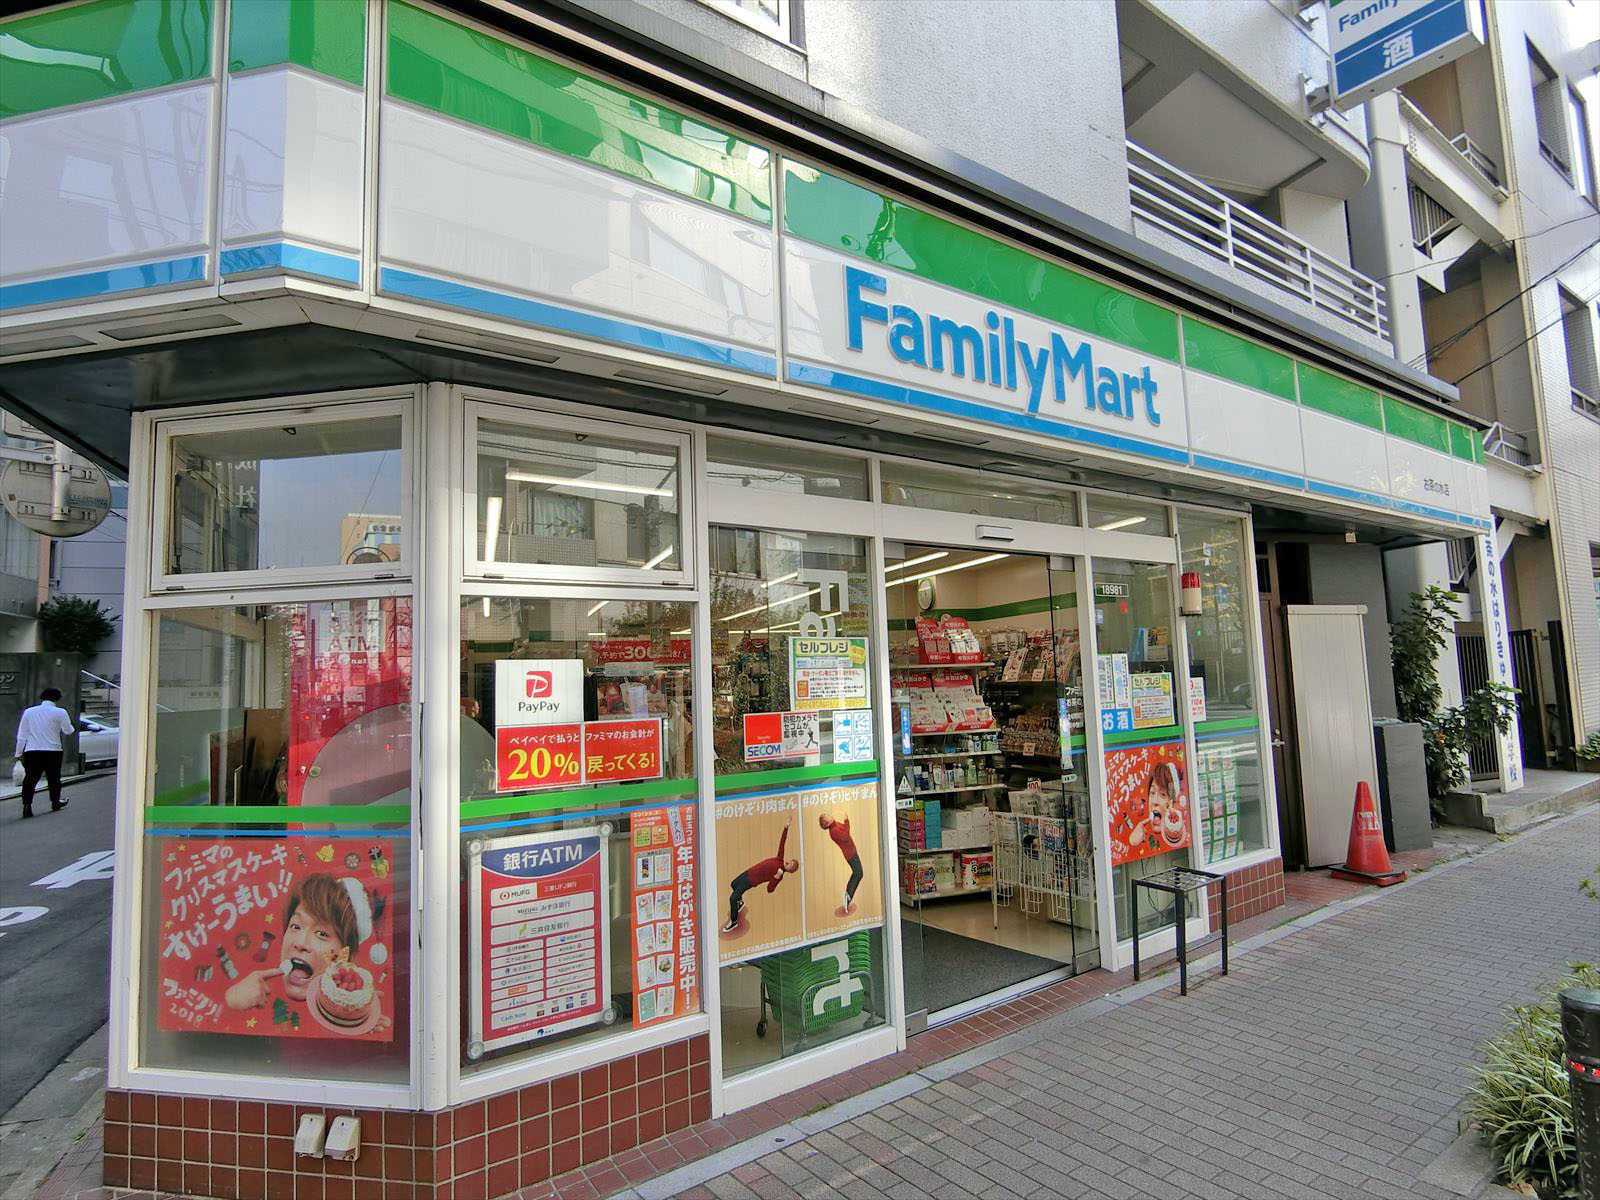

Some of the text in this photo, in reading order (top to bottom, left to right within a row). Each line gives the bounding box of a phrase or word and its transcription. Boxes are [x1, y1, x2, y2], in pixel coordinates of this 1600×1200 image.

[1339, 0, 1399, 32] Fami
[1382, 30, 1414, 69] 酒
[842, 264, 1161, 427] FamilyMart
[1100, 584, 1122, 595] 18981
[799, 641, 849, 654] セルフレジ
[518, 700, 560, 712] PayPay
[783, 722, 809, 731] セコムが
[784, 714, 818, 724] 防犯カメラで
[1103, 711, 1129, 731] お酒
[509, 733, 580, 746] ペイペイで払うと
[585, 728, 655, 741] ファミマのお会計が
[784, 730, 805, 739] 監視中
[747, 745, 781, 757] SECOM
[507, 747, 580, 781] 20%
[587, 752, 655, 774] 戻ってくる!
[802, 788, 877, 807] #のけぞりピザまん
[714, 798, 796, 820] #のけぞり肉まん
[503, 843, 583, 871] 銀行ATM
[164, 845, 234, 891] ファミマの
[171, 843, 288, 921] クリスマスケーキ
[511, 889, 530, 898] MUFG
[163, 869, 293, 960] すげーうまい!!
